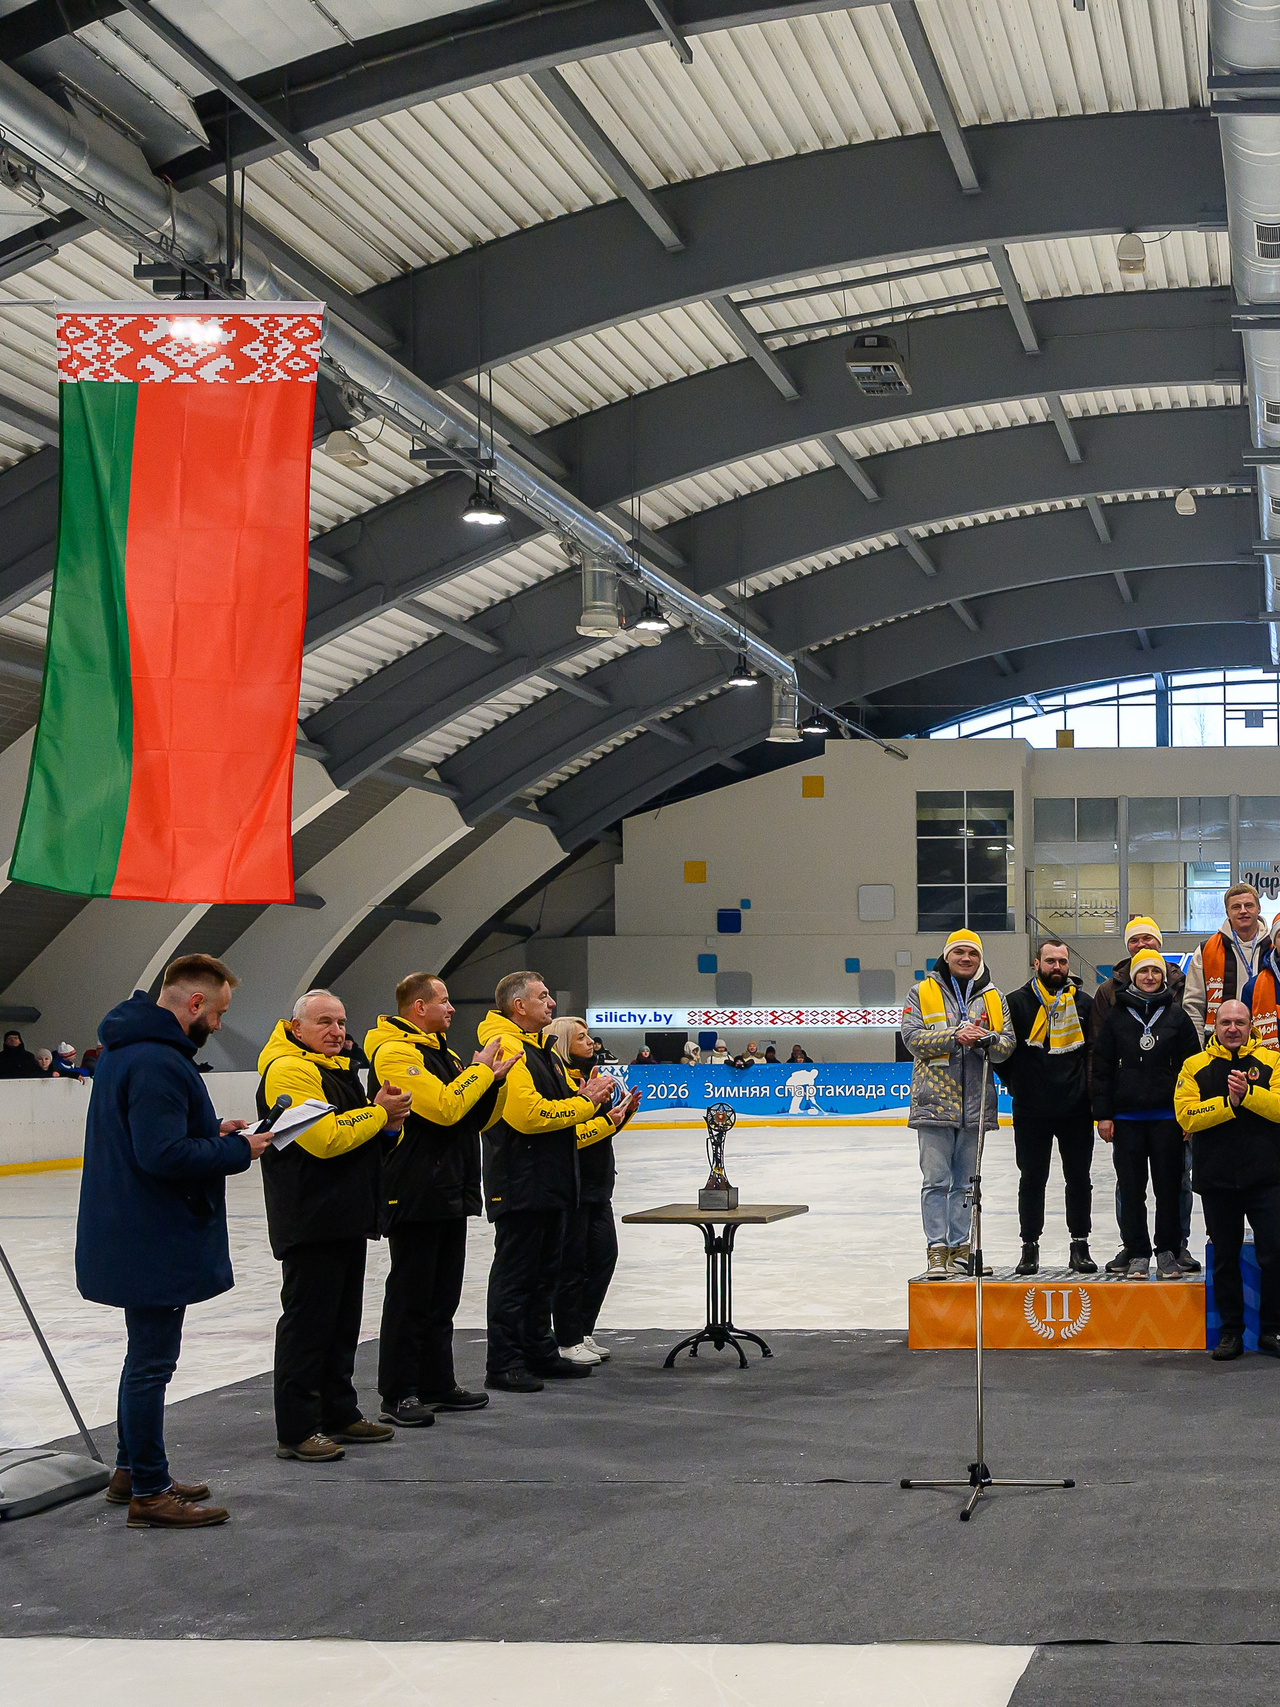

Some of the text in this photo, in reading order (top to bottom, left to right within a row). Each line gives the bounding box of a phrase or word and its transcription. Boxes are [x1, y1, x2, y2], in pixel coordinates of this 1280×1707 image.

[595, 1011, 674, 1025] silichy.by
[645, 1083, 690, 1100] 2026
[703, 1082, 771, 1099] Зимняя
[774, 1083, 886, 1101] спартакиада
[539, 1109, 576, 1119] BELARUS
[1041, 1289, 1074, 1322] II
